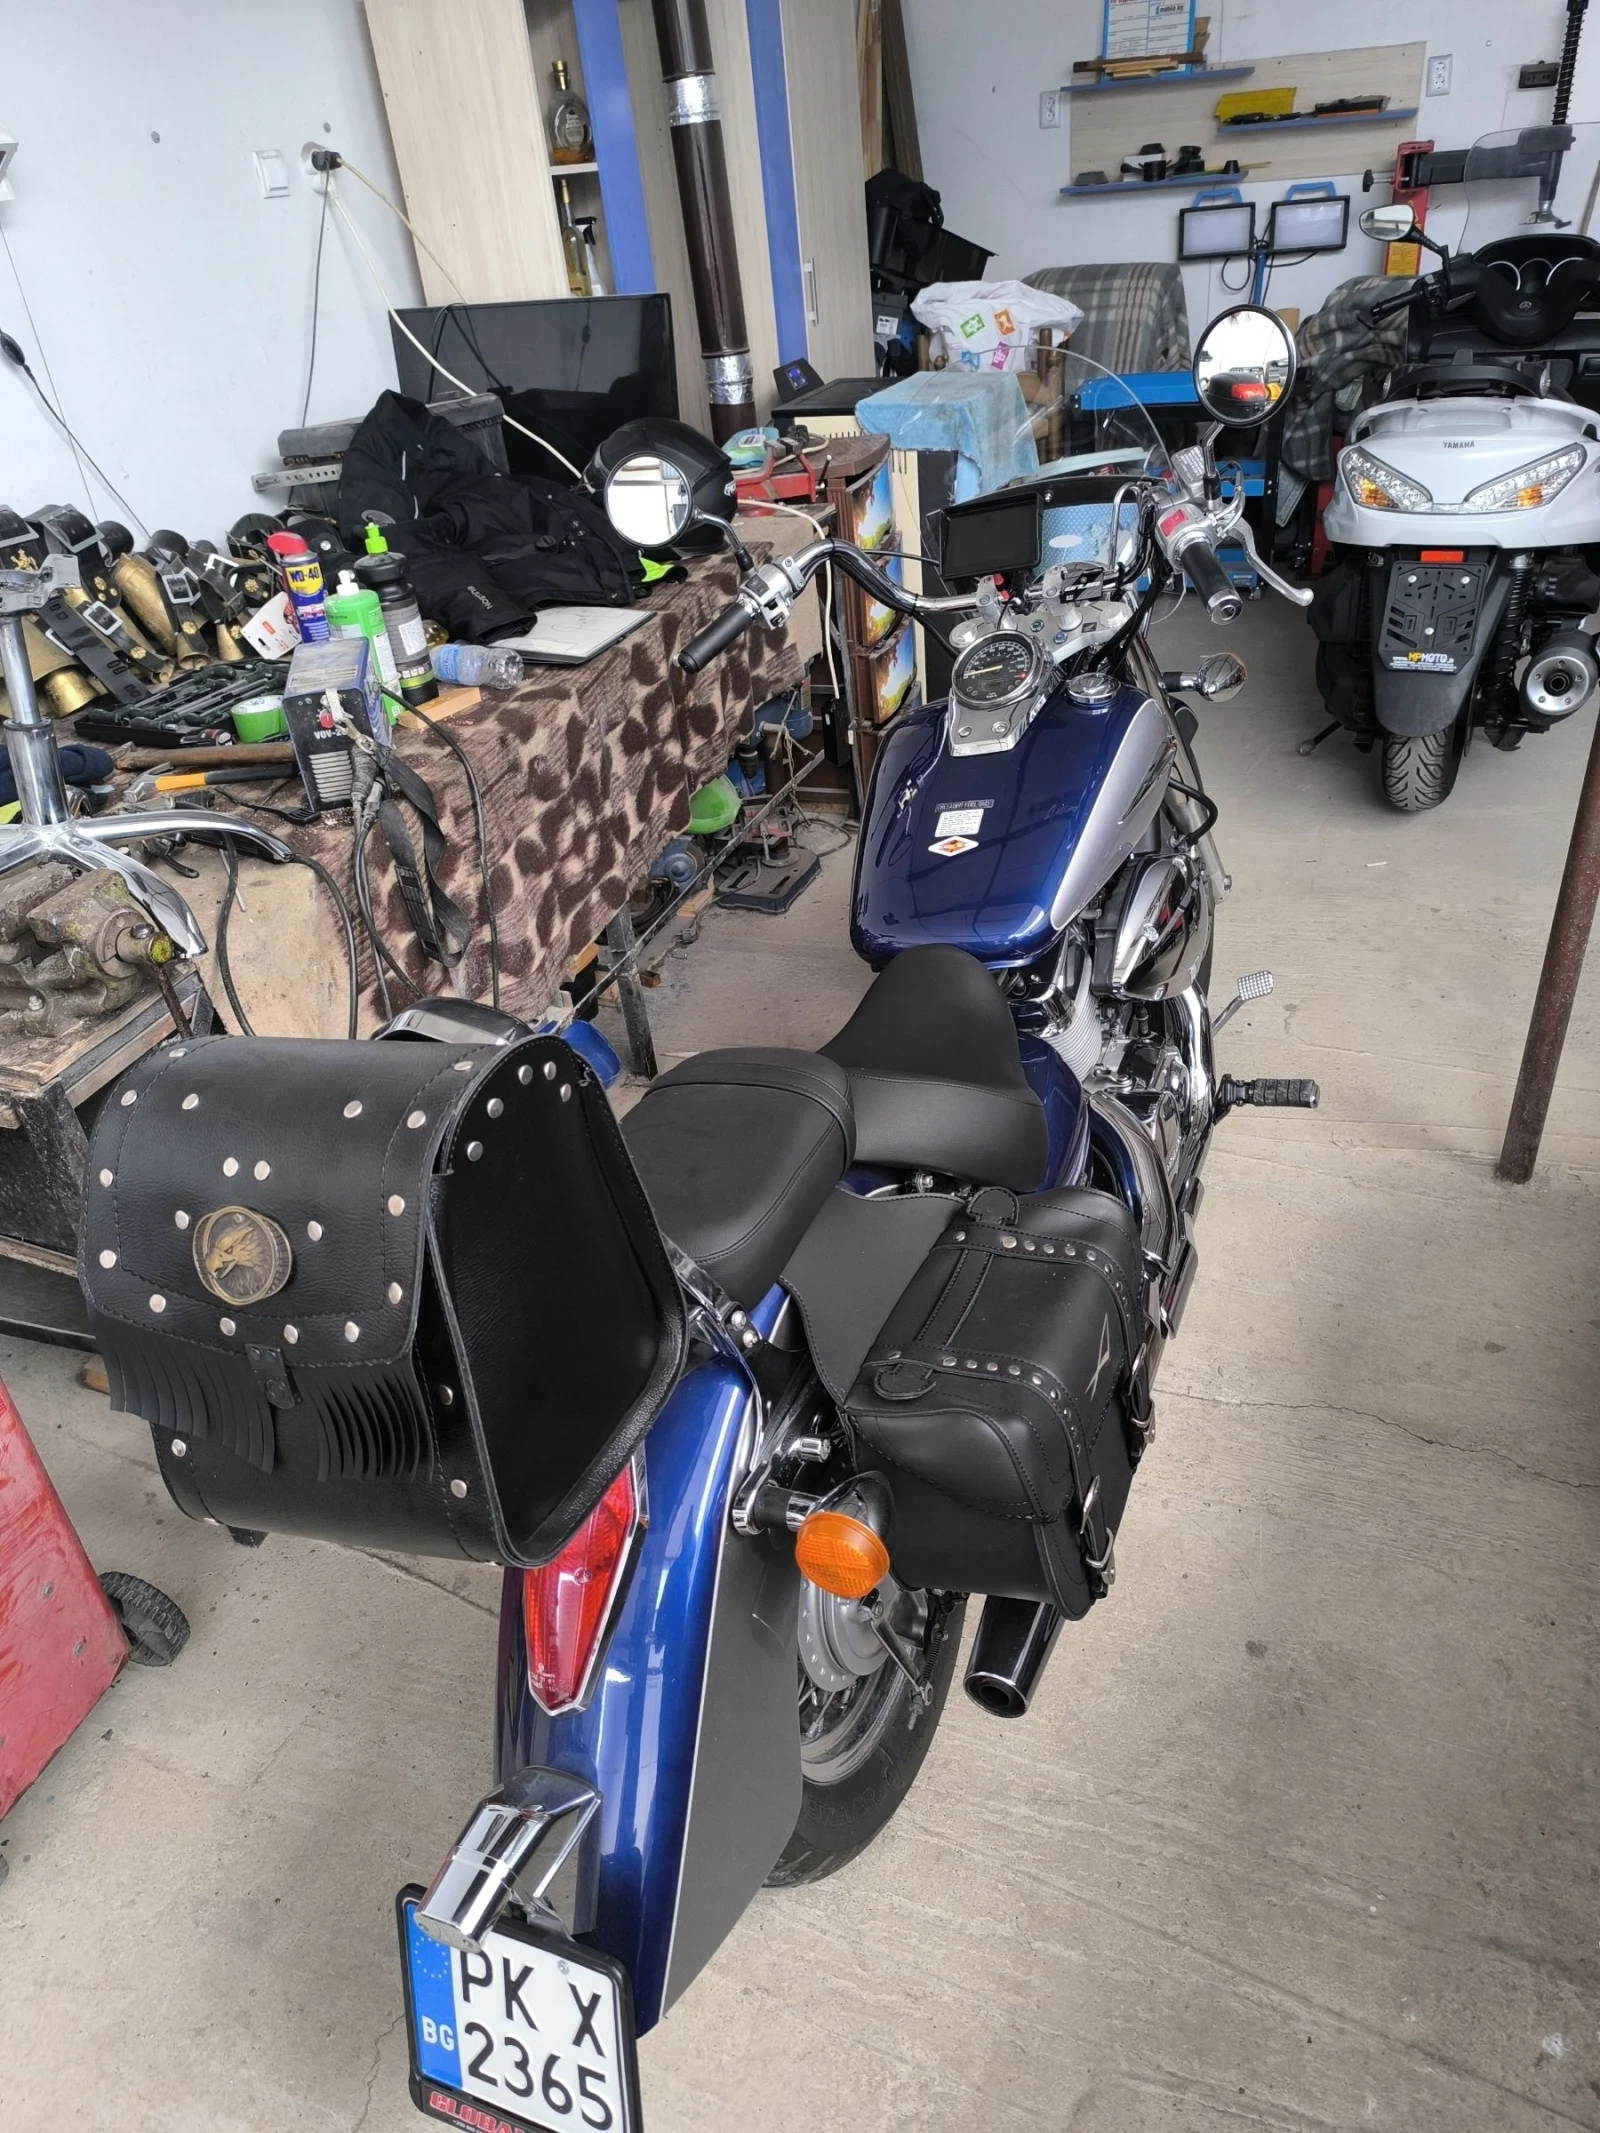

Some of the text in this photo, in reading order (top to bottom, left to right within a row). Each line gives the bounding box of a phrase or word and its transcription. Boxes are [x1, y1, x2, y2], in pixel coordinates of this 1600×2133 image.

[1443, 441, 1475, 449] YAMAHA
[289, 566, 320, 583] WD-40
[460, 1951, 607, 2059] PK X
[422, 2015, 455, 2051] BG
[464, 2021, 613, 2131] 2365
[430, 2091, 525, 2133] GLOBA
